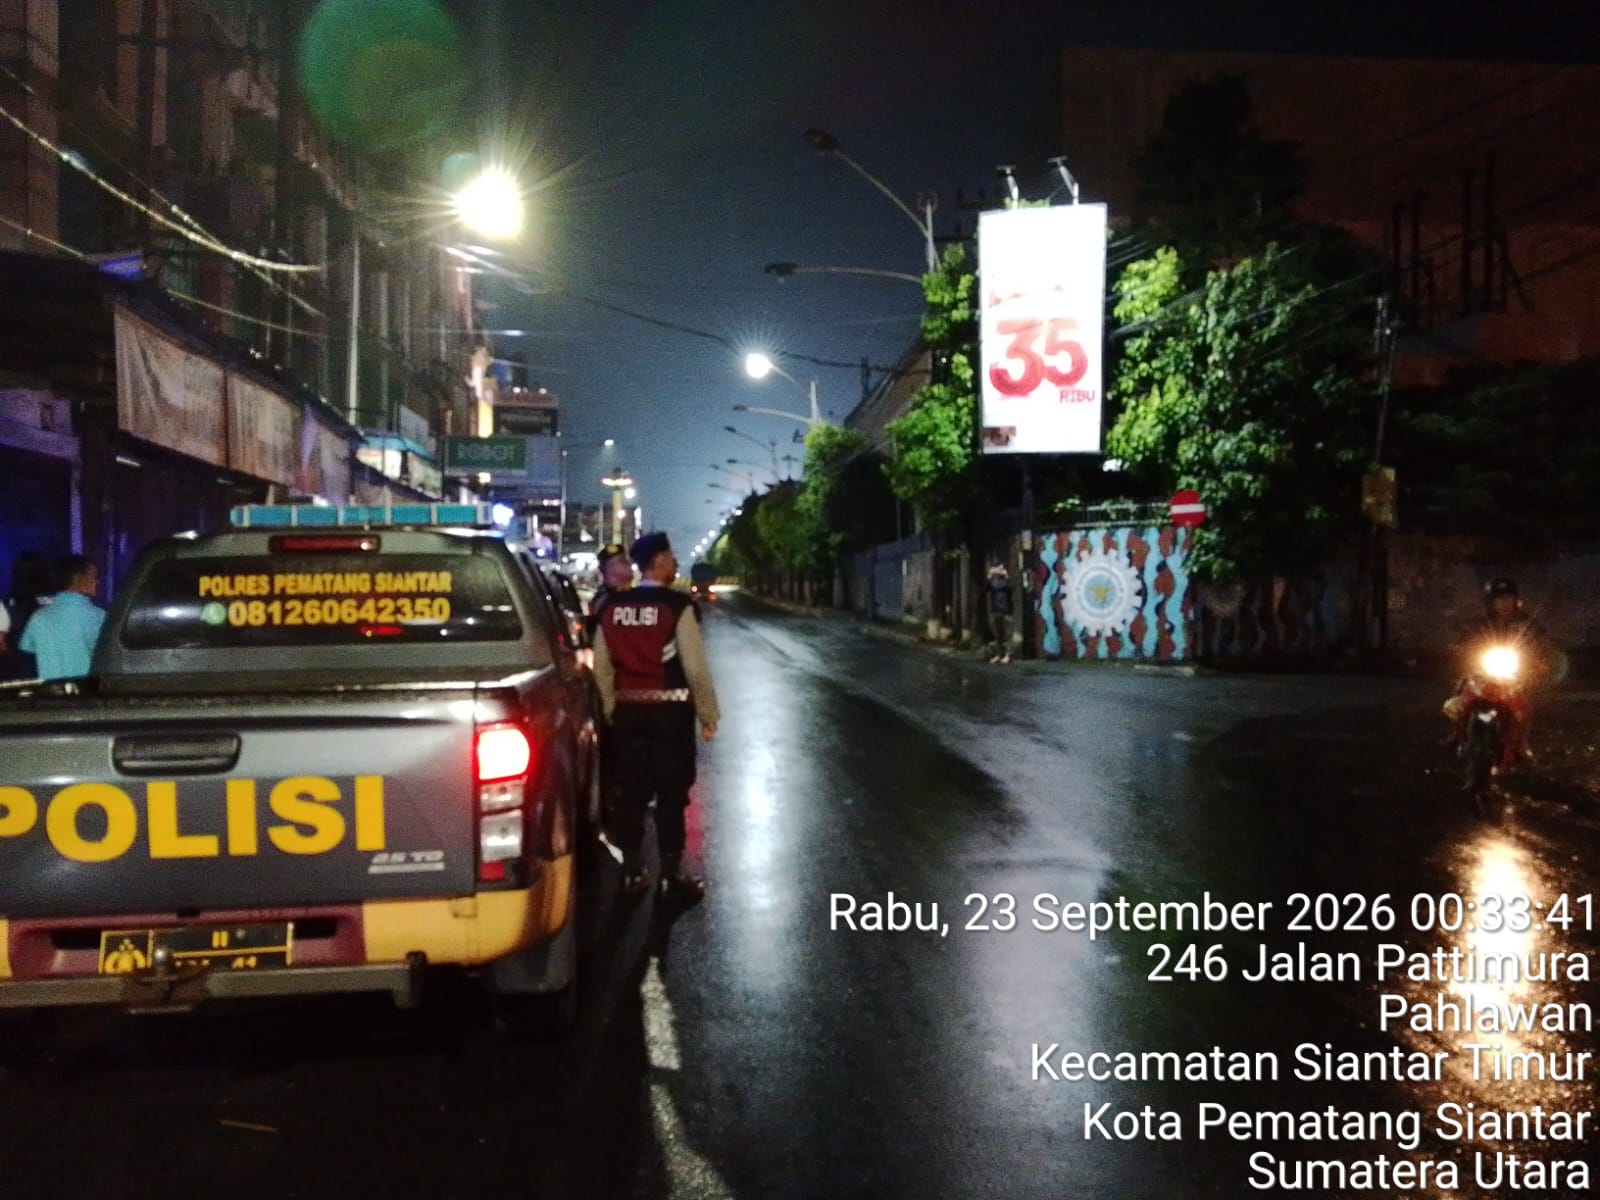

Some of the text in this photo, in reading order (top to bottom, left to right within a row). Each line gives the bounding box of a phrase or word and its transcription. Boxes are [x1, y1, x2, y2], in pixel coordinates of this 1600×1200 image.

[989, 317, 1088, 398] 35
[1059, 389, 1095, 403] RIBU
[199, 571, 452, 597] POLRES PEMATANG SIANTAR
[228, 597, 451, 626] 081260642350
[612, 606, 659, 627] POLISI
